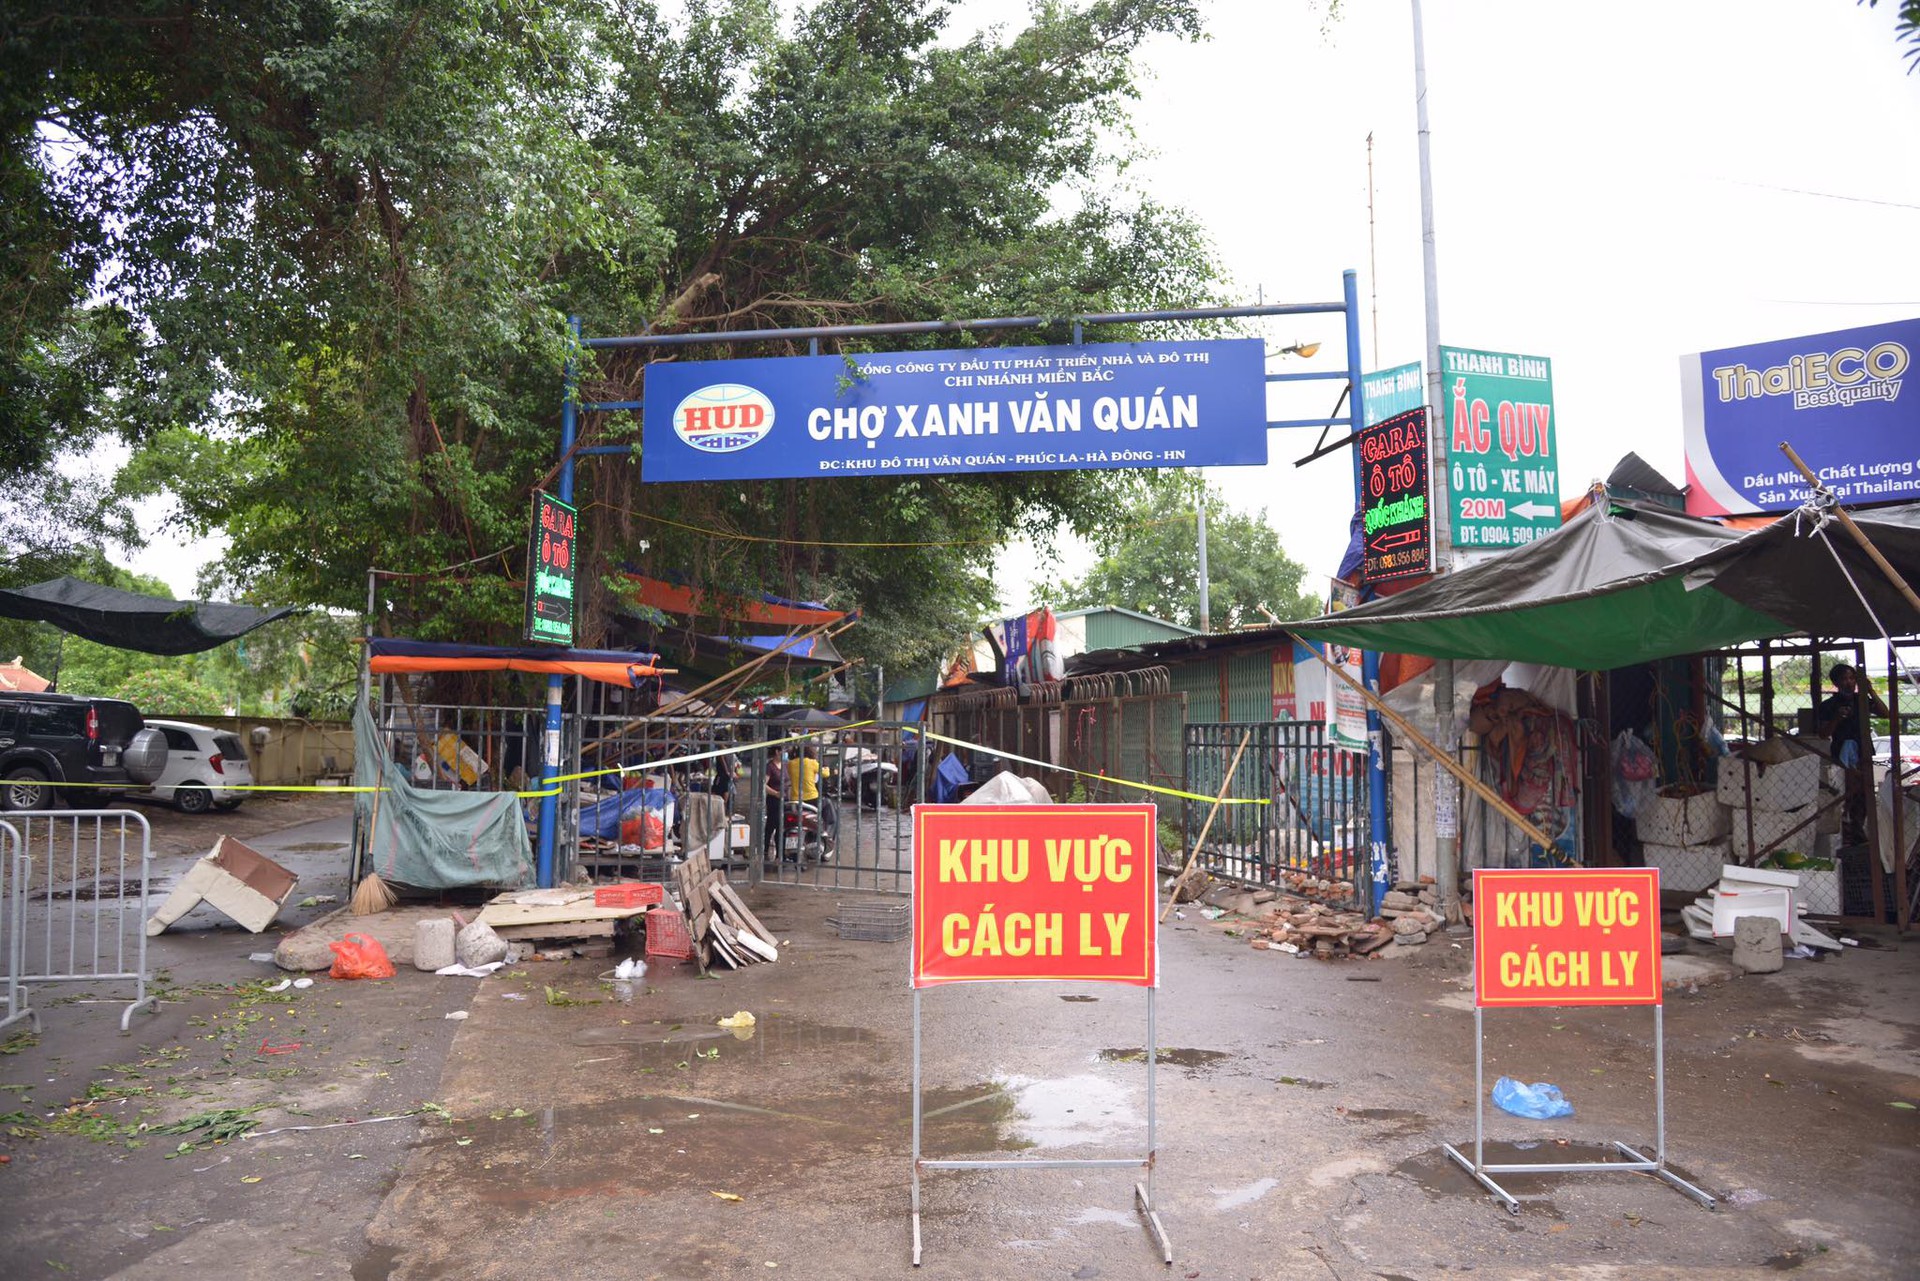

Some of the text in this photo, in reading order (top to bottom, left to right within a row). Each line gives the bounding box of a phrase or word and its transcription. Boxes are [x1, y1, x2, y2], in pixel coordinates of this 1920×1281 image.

[895, 361, 935, 374] CÔNG
[938, 362, 956, 372] TY
[960, 358, 989, 372] ĐẦU
[992, 359, 1013, 370] TƯ
[1014, 356, 1052, 369] PHÁT
[1102, 353, 1134, 366] NHÀ
[1137, 352, 1155, 364] VÀ
[1158, 351, 1180, 363] ĐÔ
[1184, 352, 1210, 364] THỊ
[944, 366, 1115, 387] CHI NHÁNH MIỀN BẮC
[1446, 352, 1547, 379] THANH BÌNH
[1713, 341, 1910, 402] ThaiECO
[1364, 368, 1420, 398] THANH BÌNH
[1794, 378, 1903, 410] Best quality
[683, 404, 764, 432] HUD
[807, 386, 1198, 448] CHỢ XANH VĂN QUÁN
[1452, 377, 1550, 462] ẮC QUY
[1363, 421, 1421, 463] GARA
[881, 456, 901, 468] ĐÔ
[904, 458, 930, 469] THỊ
[933, 454, 962, 466] VĂN
[965, 453, 1006, 466] QUÁN
[1016, 451, 1056, 464] PHÚC
[1111, 449, 1153, 461] ĐÔNG
[1164, 450, 1186, 460] HN
[1744, 474, 1774, 488] Dầu
[1778, 471, 1816, 484] Nh
[1819, 464, 1856, 480] Chất
[1860, 461, 1912, 477] Lượng
[1370, 454, 1416, 497] Ô TÔ
[1452, 462, 1464, 492] Ô
[1467, 462, 1487, 492] TÔ
[1501, 468, 1522, 494] XE
[1524, 466, 1555, 494] MÁY
[1460, 498, 1506, 520] 20M
[1758, 490, 1786, 504] Sản
[542, 504, 574, 539] GARA
[1460, 526, 1478, 544] ĐT:
[1481, 526, 1510, 544] 0904
[1512, 526, 1533, 544] 509
[542, 532, 569, 569] Ô TÔ
[939, 834, 1132, 892] KHU VỰC
[1496, 888, 1640, 934] KHU VỰC
[942, 904, 1130, 957] CÁCH LY
[1500, 944, 1639, 988] CÁCH LY
